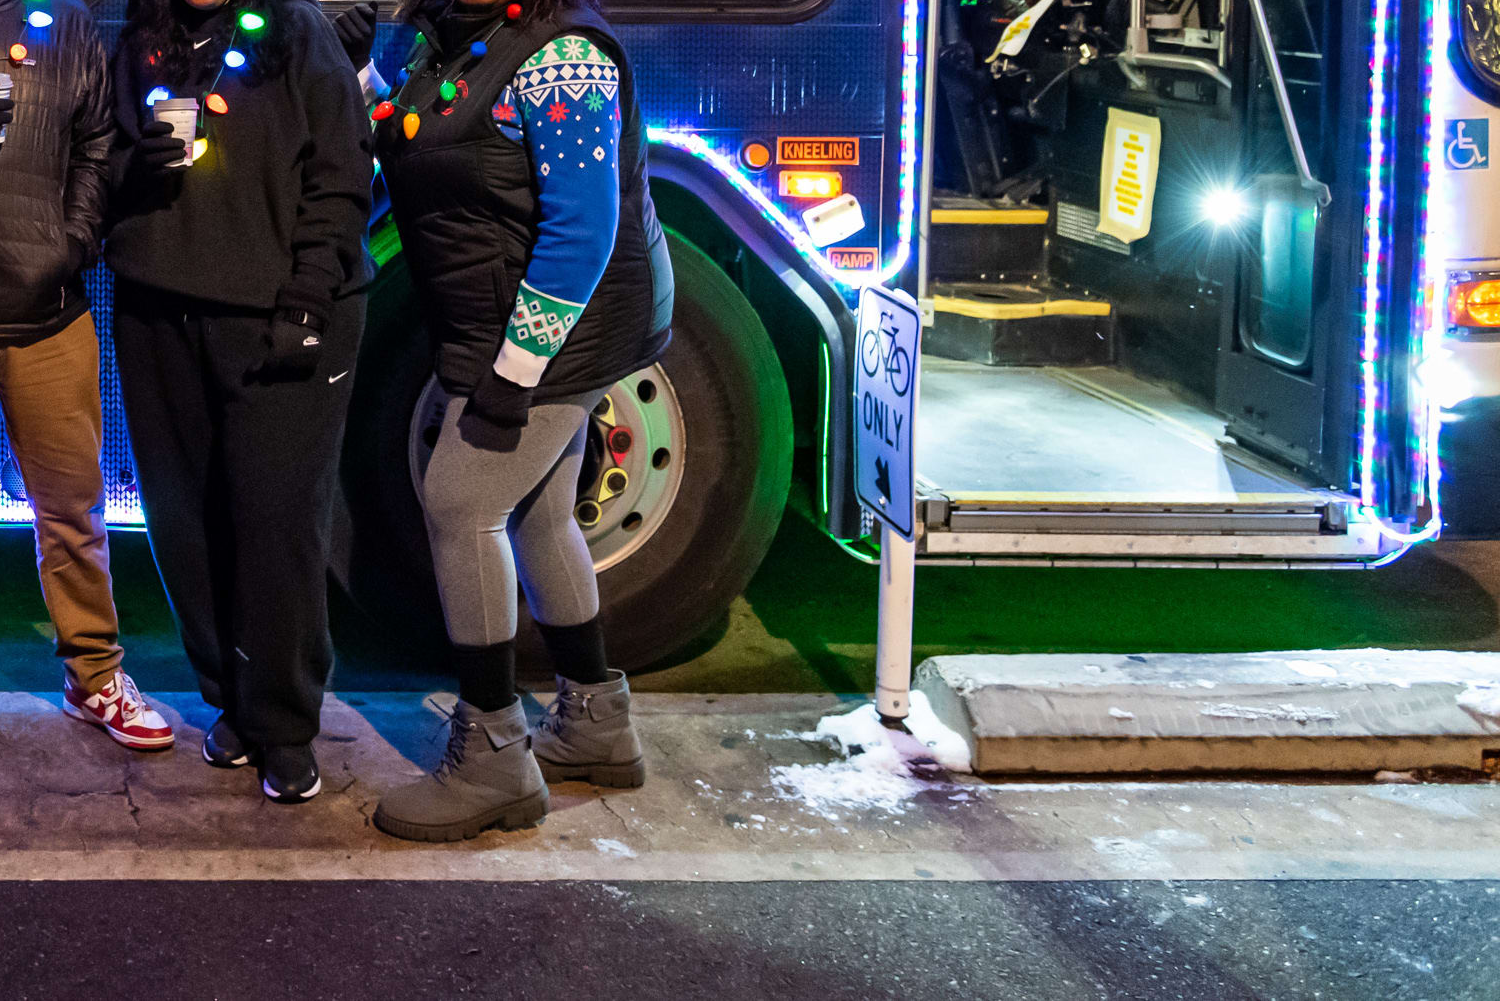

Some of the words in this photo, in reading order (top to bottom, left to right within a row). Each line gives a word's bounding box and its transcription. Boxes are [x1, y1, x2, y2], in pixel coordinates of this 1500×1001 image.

[783, 142, 853, 159] KNEELING
[832, 253, 873, 268] RAMP
[863, 390, 904, 452] ONLY
